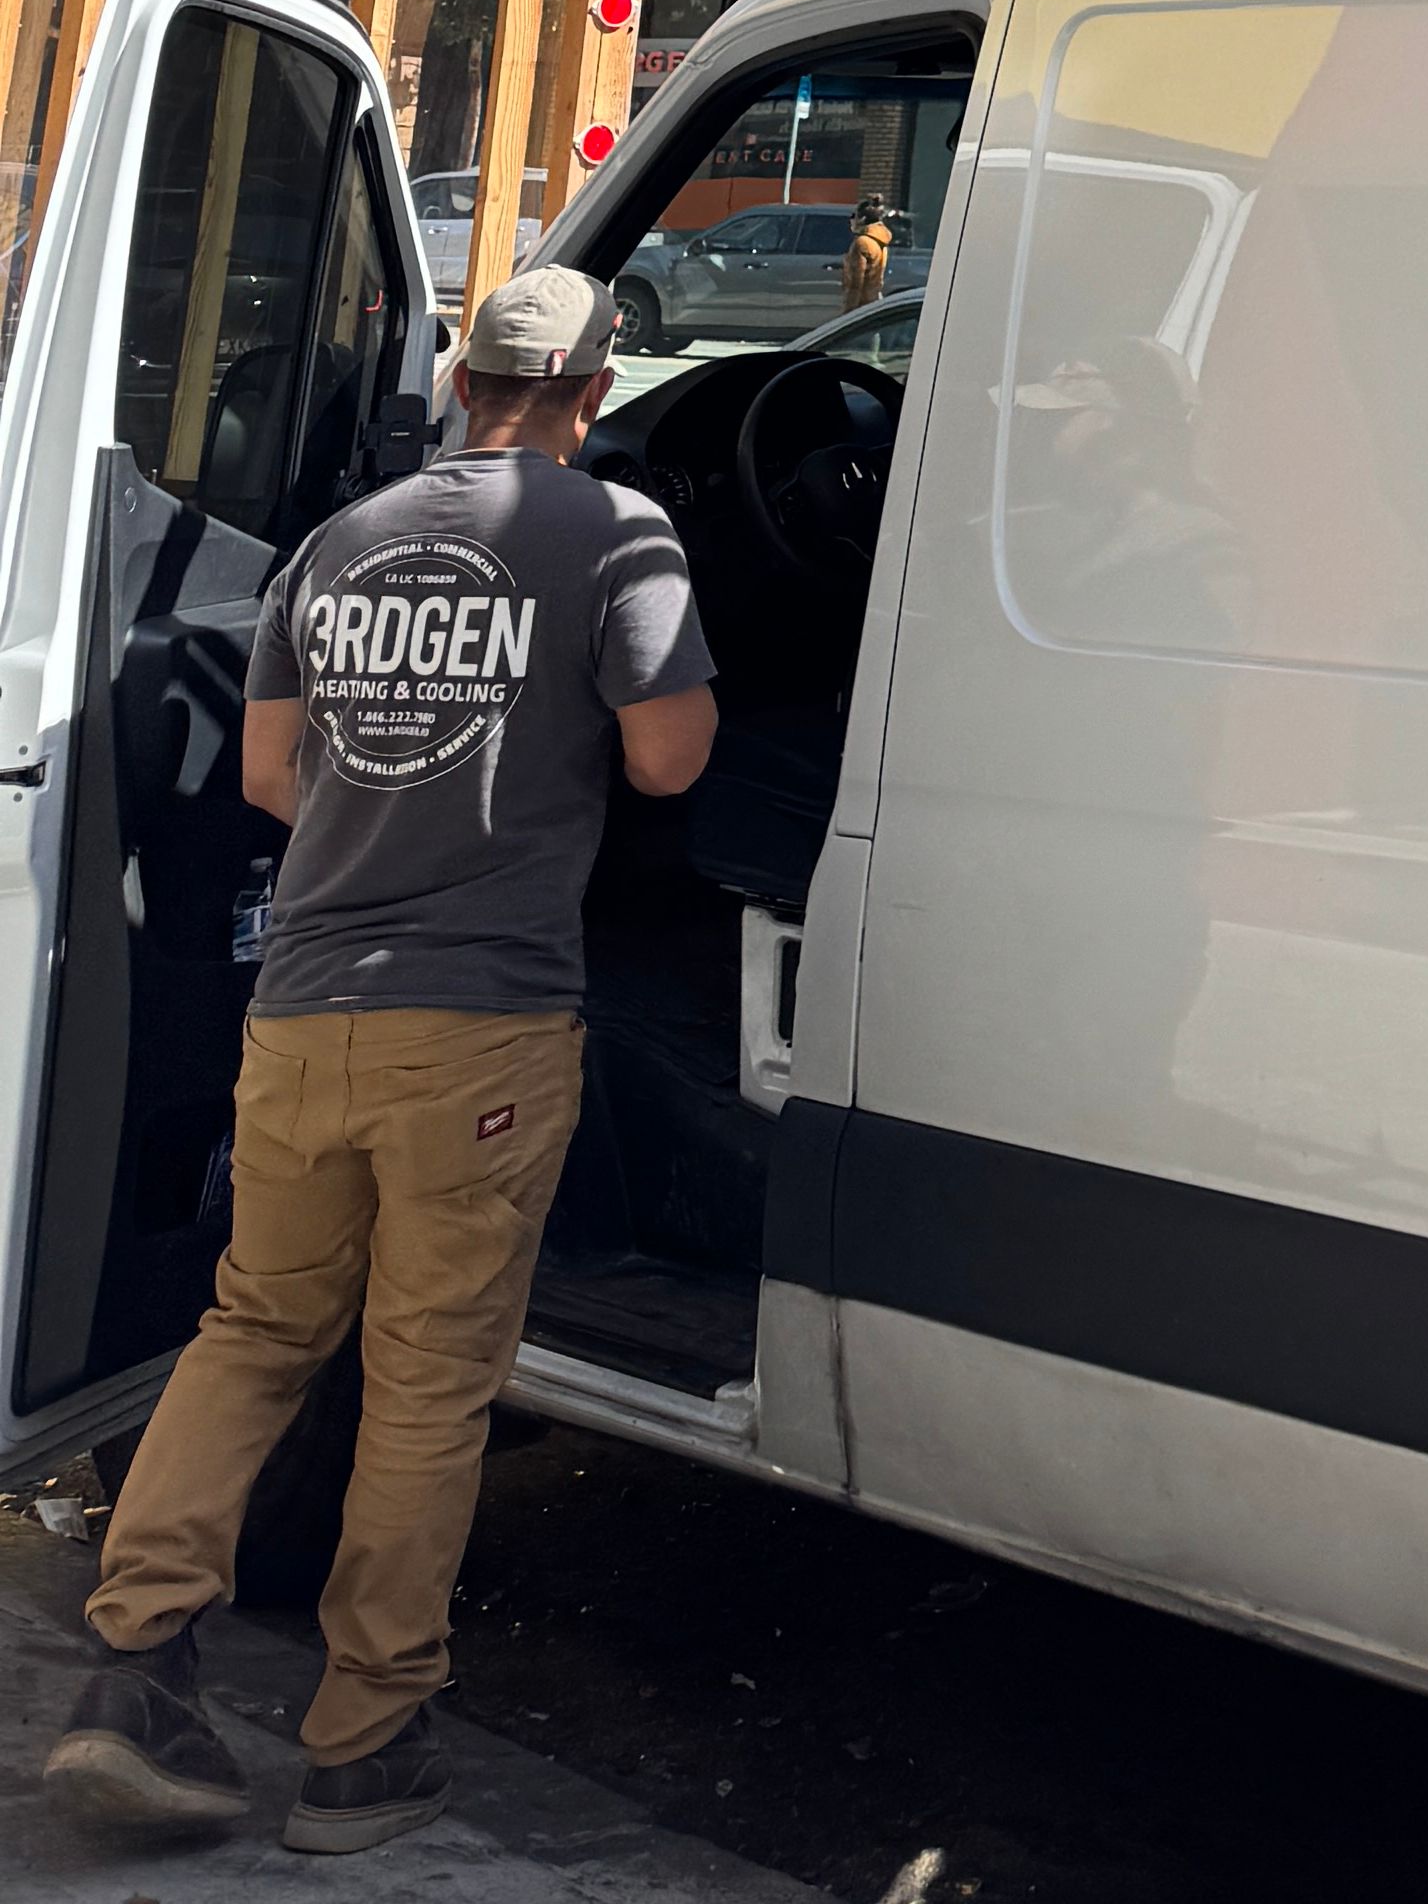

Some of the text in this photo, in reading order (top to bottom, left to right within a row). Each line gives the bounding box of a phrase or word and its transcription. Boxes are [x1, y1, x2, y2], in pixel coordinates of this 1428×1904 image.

[433, 542, 498, 582] COMMERCIAL
[308, 593, 537, 679] 3RDGEN
[312, 679, 507, 704] HEATING & COOLING
